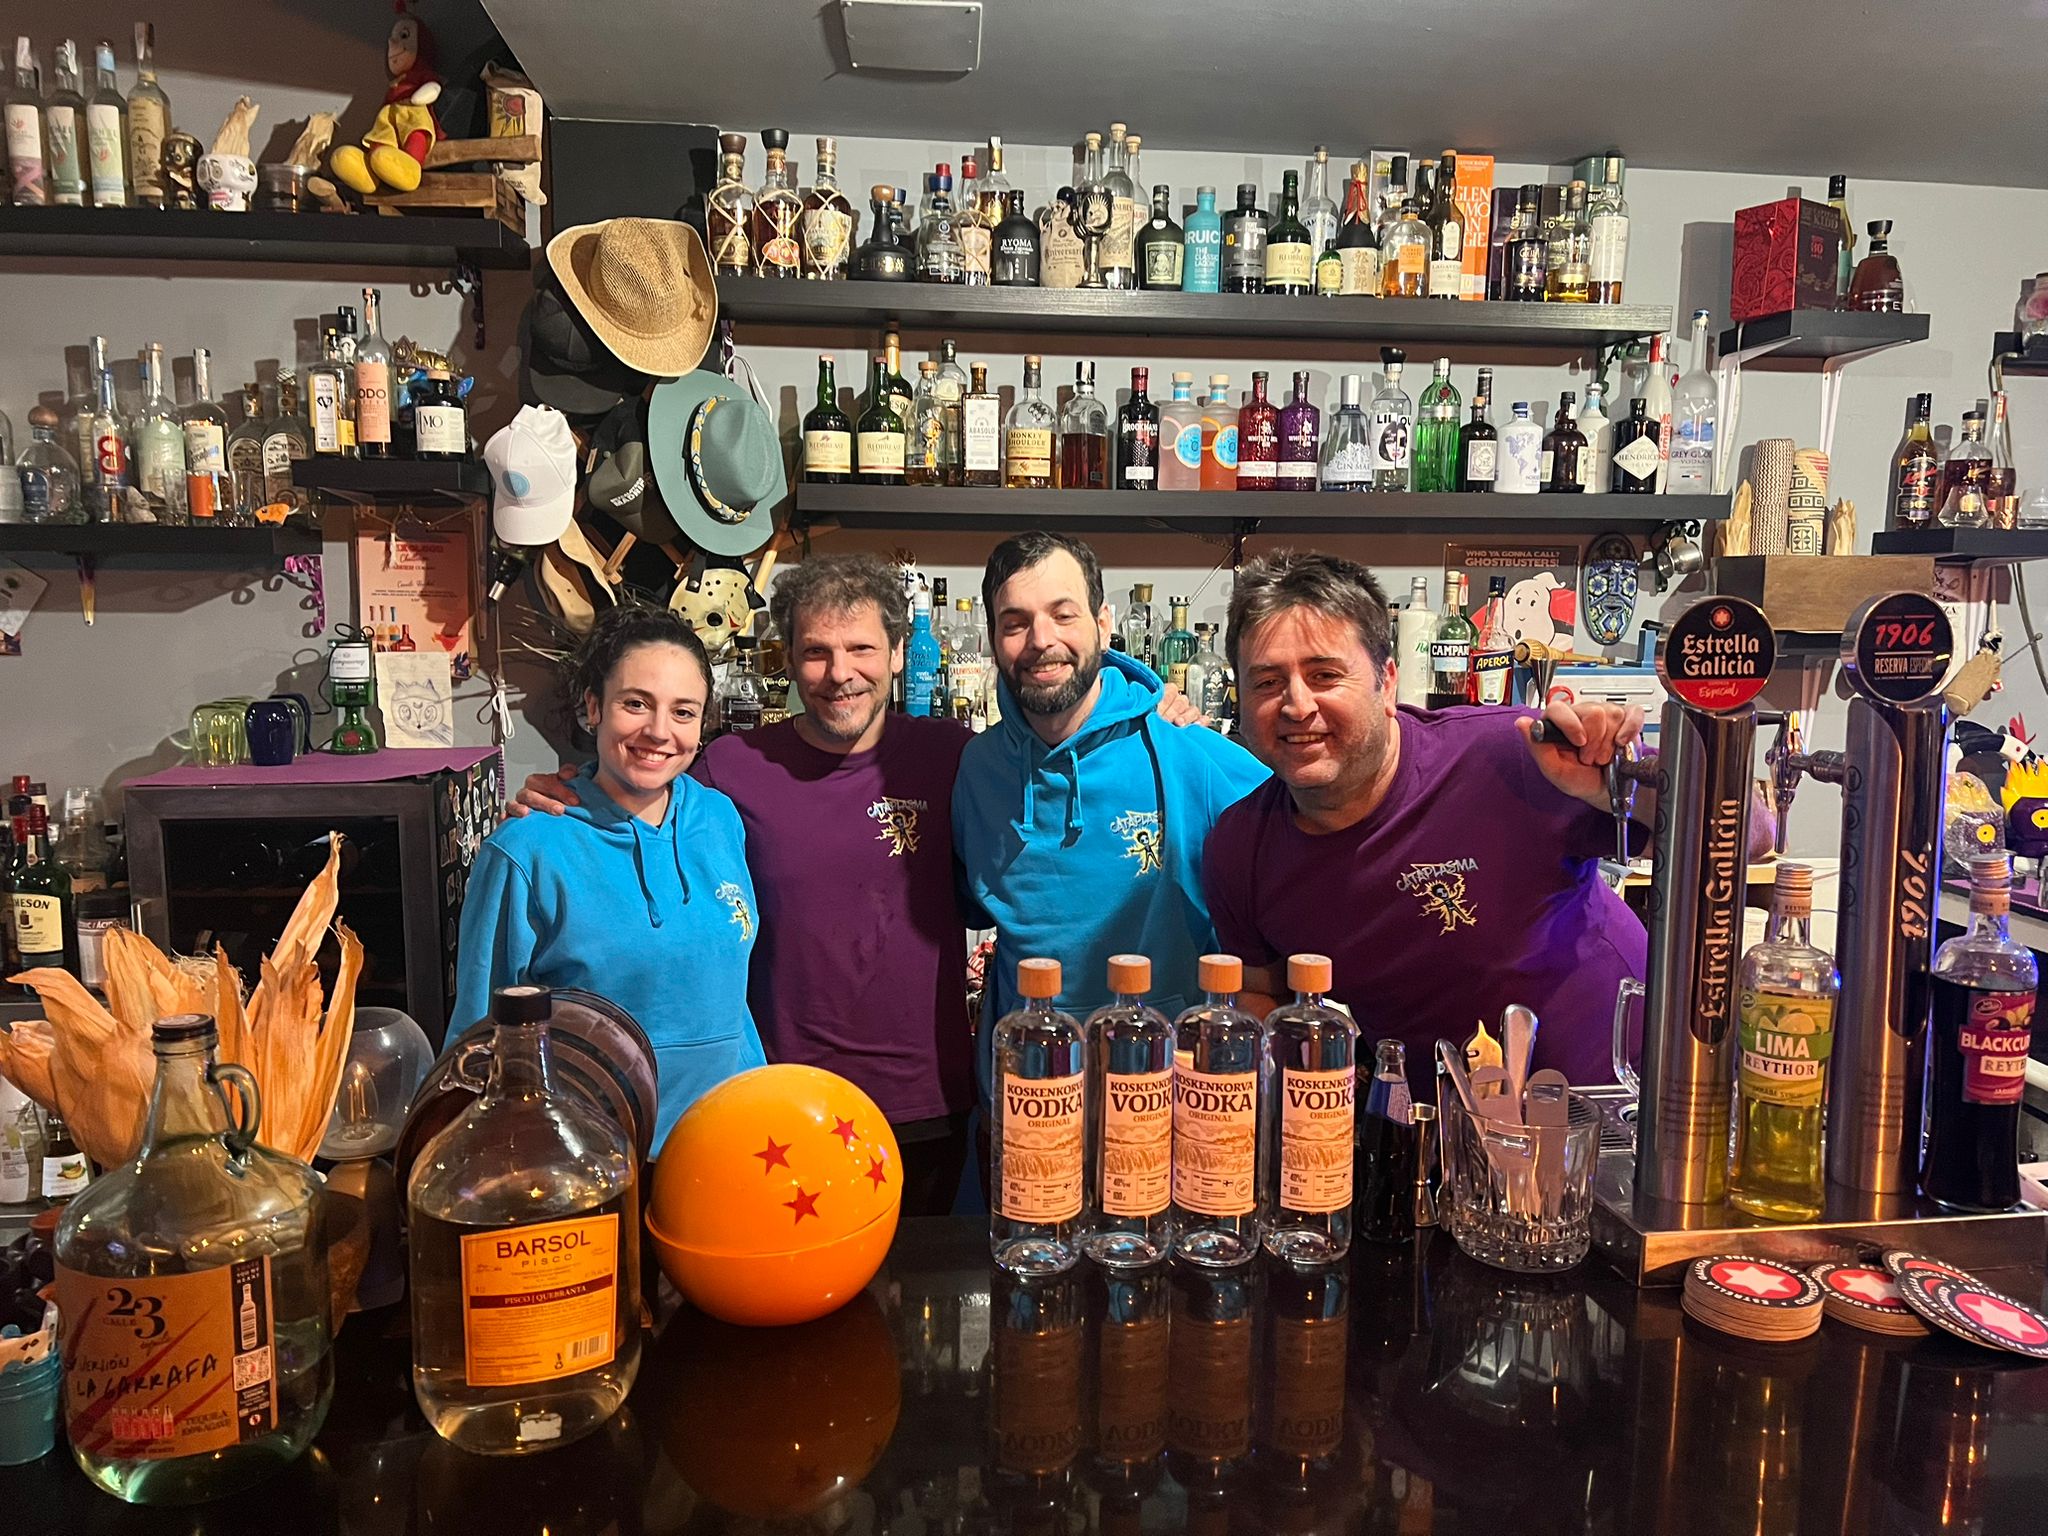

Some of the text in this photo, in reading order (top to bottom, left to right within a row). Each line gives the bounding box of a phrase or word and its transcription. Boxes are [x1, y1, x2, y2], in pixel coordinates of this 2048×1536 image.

[1001, 238, 1032, 247] RYOMA
[1184, 229, 1220, 245] BRUIC
[1465, 557, 1560, 568] GHOSTBUSTERS!
[1466, 550, 1487, 558] WHO
[1488, 550, 1499, 558] YA
[1681, 633, 1760, 655] Estrella
[1873, 620, 1936, 649] 1906
[1476, 657, 1510, 669] APEROL
[1684, 655, 1755, 676] Galicia
[1874, 656, 1908, 674] RESERVA
[1698, 684, 1739, 698] Especial
[1396, 857, 1479, 892] CATAPLASMA
[1900, 849, 1929, 939] 1906
[1700, 799, 1739, 1019] Estrella Galicia
[1755, 1030, 1811, 1059] LIMA
[1744, 1053, 1815, 1077] REYTHOR
[1007, 1093, 1083, 1119] VODKA
[1175, 1083, 1253, 1114] VODKA
[1287, 1087, 1355, 1111] VODK
[1027, 1117, 1072, 1129] ORIGINAL
[1188, 1110, 1234, 1123] ORIGINAL
[496, 1230, 591, 1259] BARSOL
[521, 1253, 573, 1268] PISCO
[1705, 1280, 1770, 1306] ESTRELLA
[106, 1286, 167, 1340] 23
[1980, 1328, 2026, 1351] DESDE
[76, 1353, 218, 1400] LA GARRAFA
